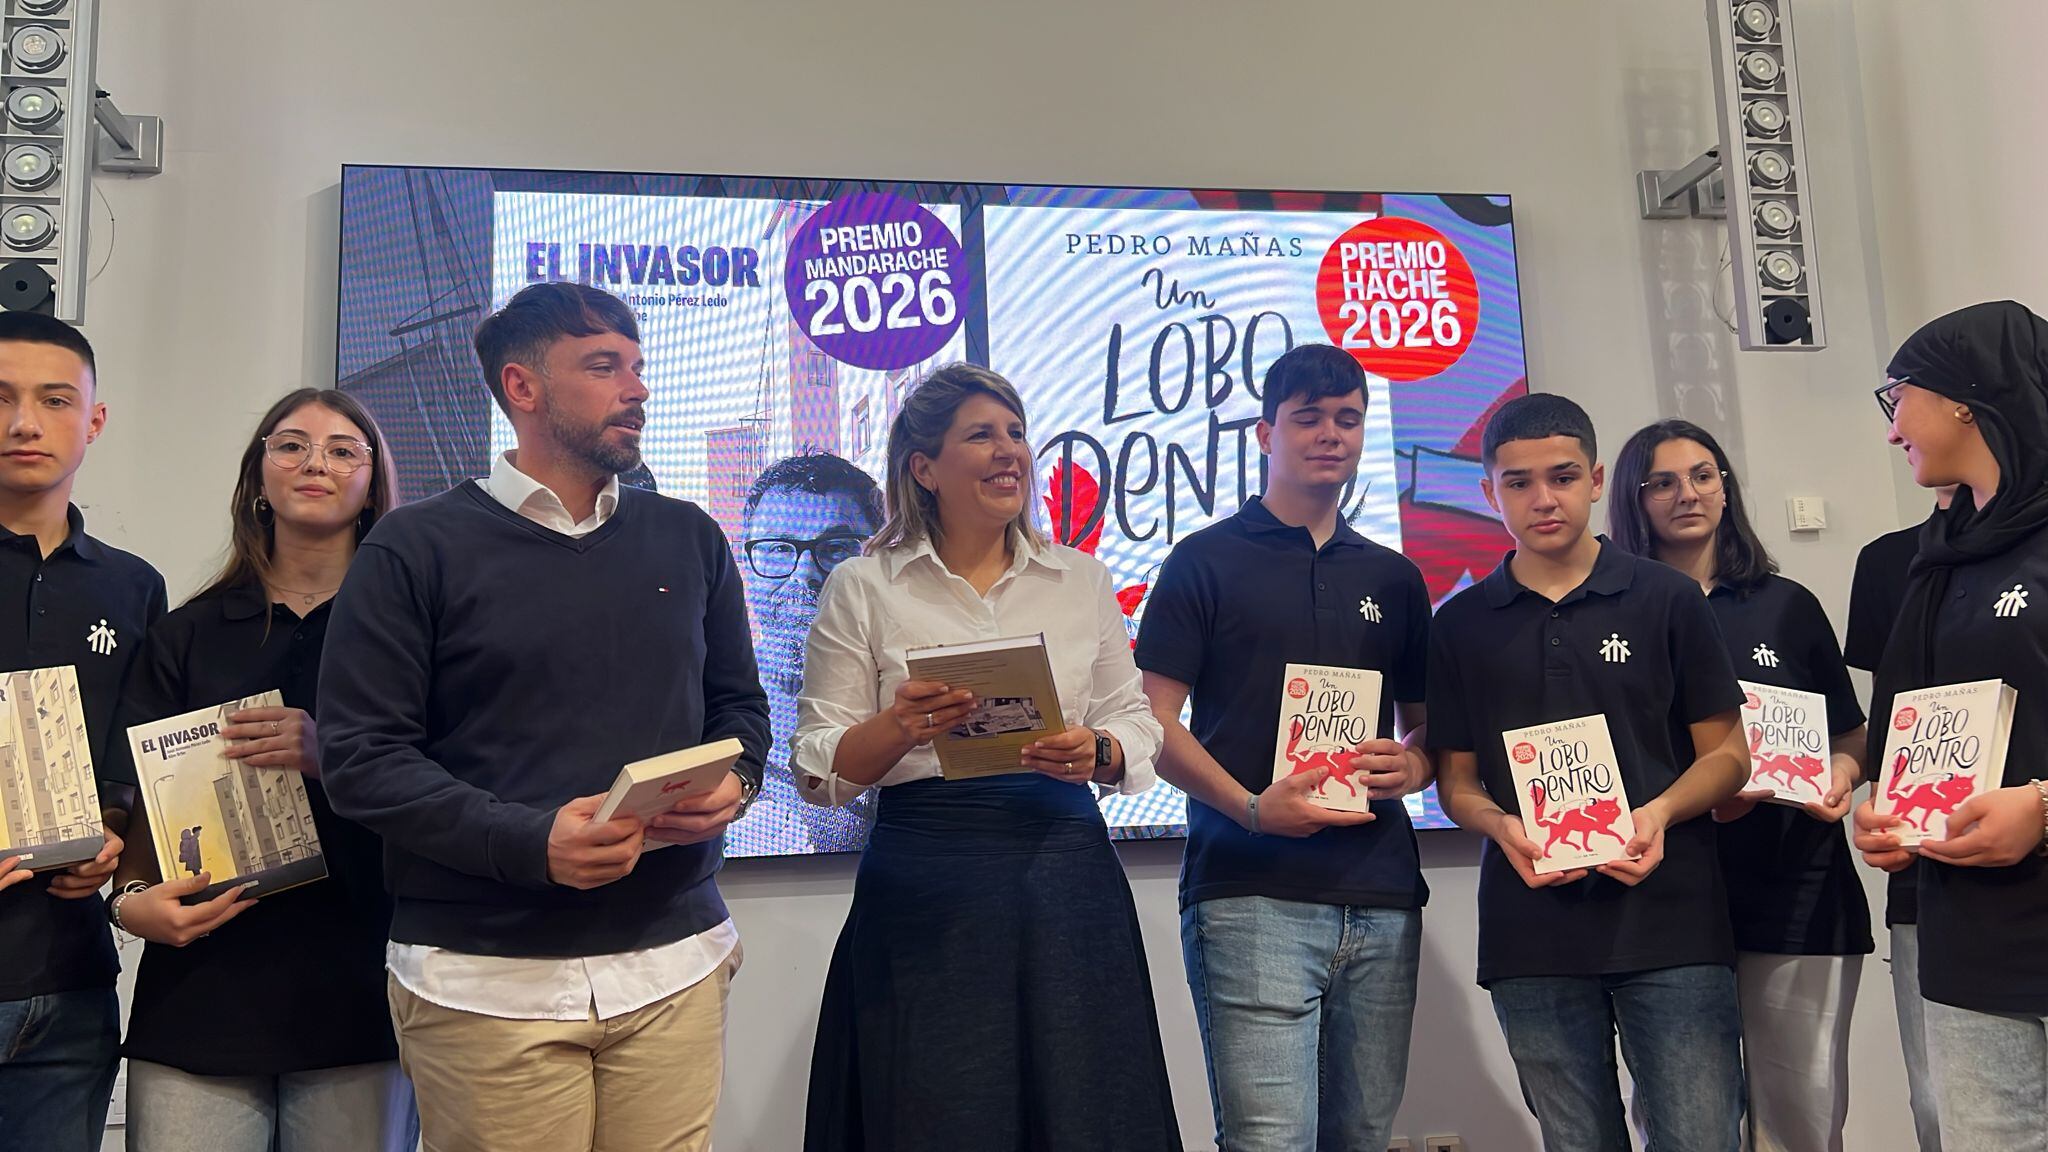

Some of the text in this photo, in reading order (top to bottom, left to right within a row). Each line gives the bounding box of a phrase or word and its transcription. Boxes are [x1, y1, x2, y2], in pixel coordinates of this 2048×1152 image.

[820, 221, 923, 254] PREMIO
[1066, 232, 1303, 257] PEDRO MAÑAS
[526, 242, 761, 288] EL INVASOR
[804, 247, 949, 280] MANDARACHE
[1340, 241, 1446, 270] PREMIO
[621, 292, 728, 307] Antonio Pérez Ledo
[1140, 268, 1216, 311] Un
[1342, 269, 1450, 301] HACHE
[804, 269, 957, 337] 2026
[1338, 299, 1462, 349] 2026
[1103, 311, 1295, 425] LOBO
[1303, 668, 1329, 677] PEDRO
[1319, 678, 1337, 689] Un
[1305, 690, 1355, 714] LOBO
[1911, 692, 1941, 702] PEDRO
[1929, 701, 1950, 713] Un
[1762, 704, 1806, 725] LOBO
[1912, 708, 1969, 744] LOBO
[141, 738, 157, 754] EL
[158, 722, 220, 760] INVASOR
[1523, 727, 1552, 738] PEDRO
[1544, 735, 1566, 747] Un
[1539, 740, 1588, 776] LOBO
